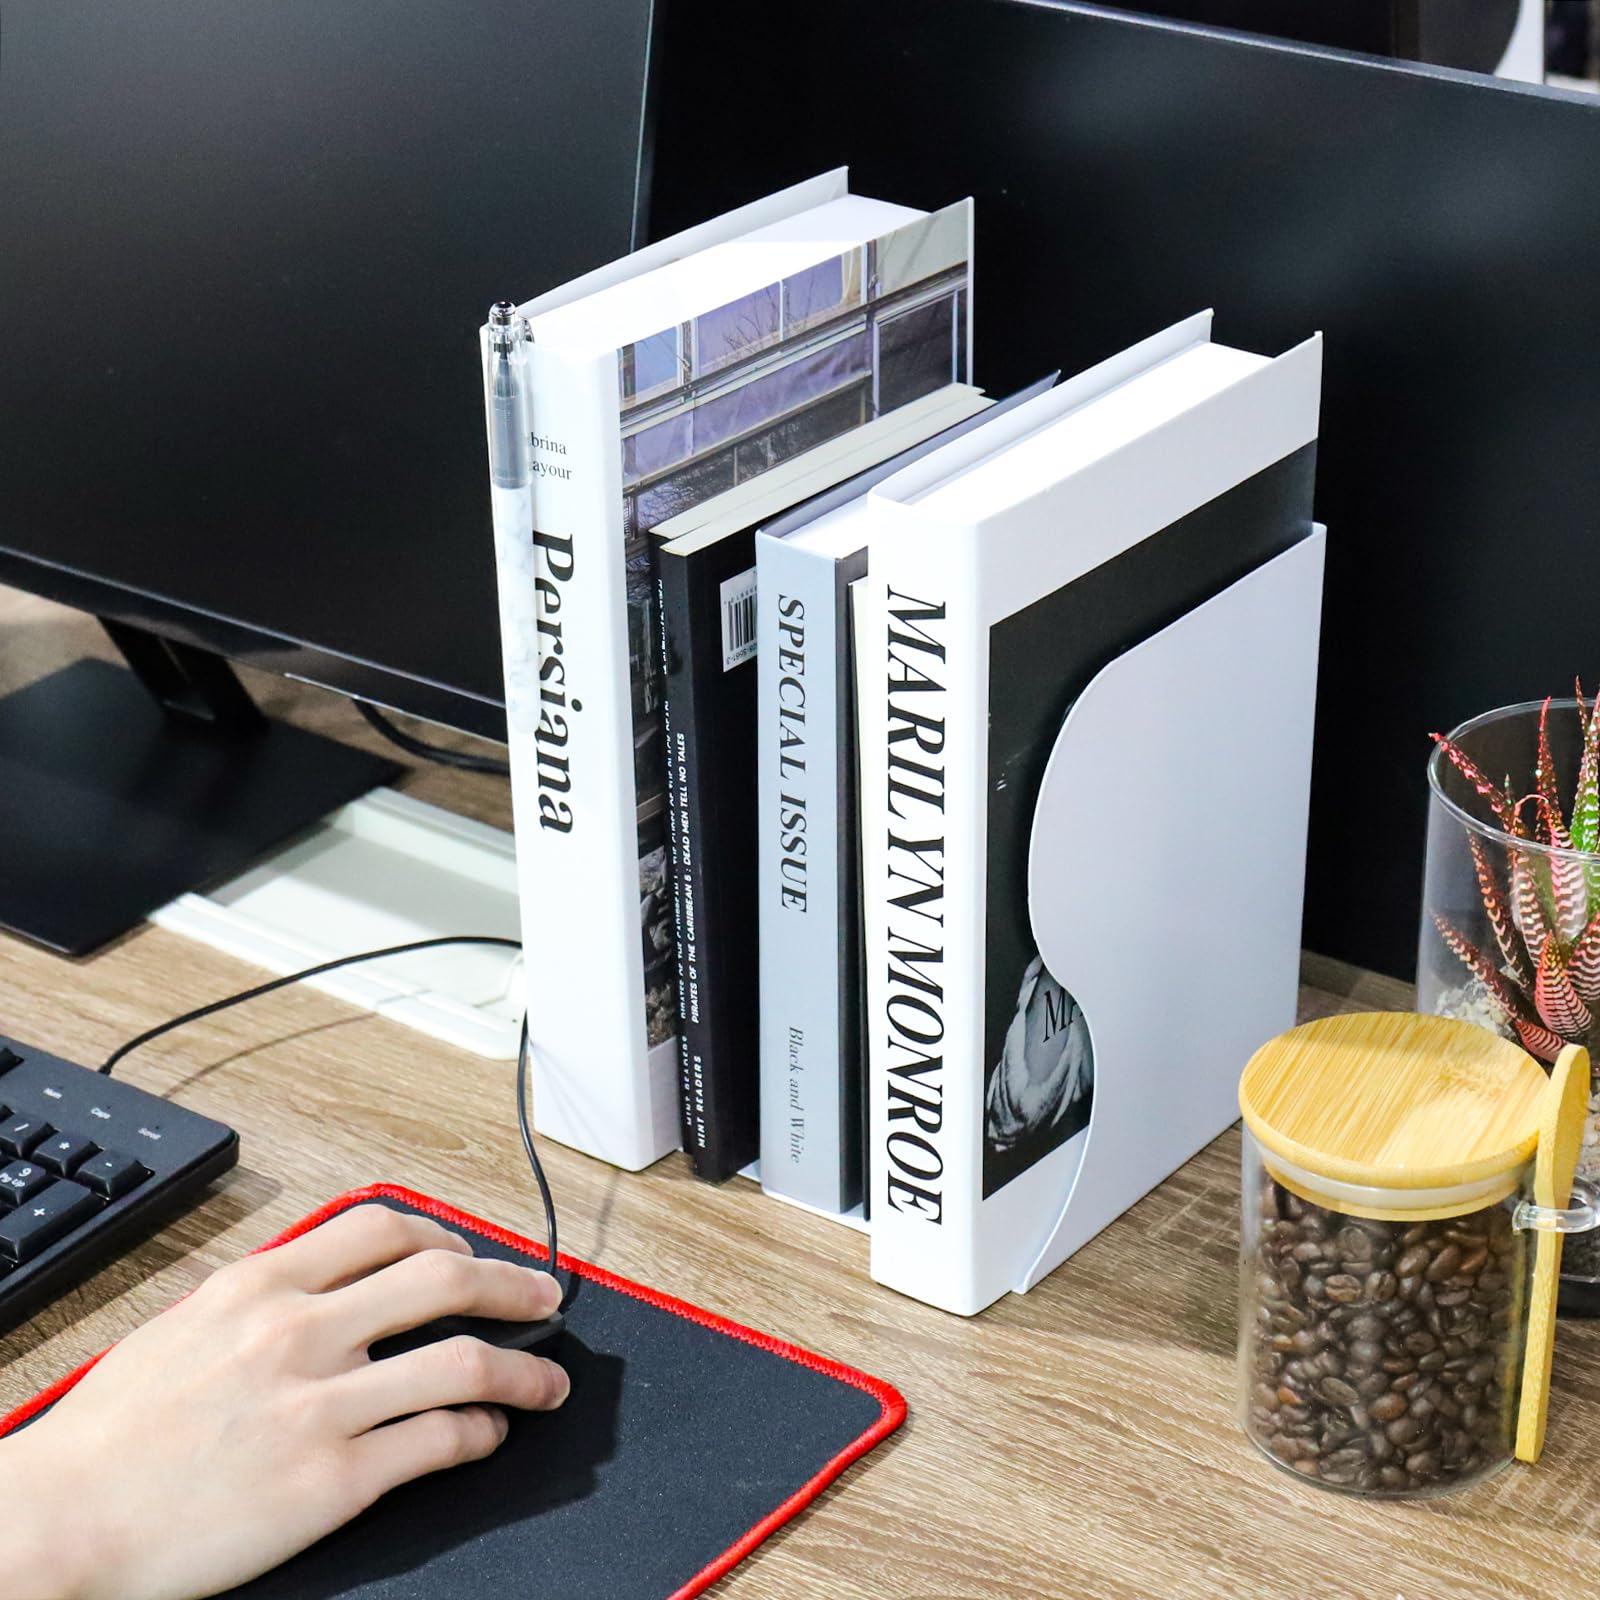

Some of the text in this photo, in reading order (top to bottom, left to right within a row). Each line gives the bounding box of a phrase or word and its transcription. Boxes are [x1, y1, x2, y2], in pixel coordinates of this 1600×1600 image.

[529, 431, 567, 455] brina
[531, 460, 573, 480] ayour
[533, 529, 583, 833] Persiana
[677, 733, 685, 762] TALES
[778, 594, 807, 913] SPECIAL ISSUE
[679, 766, 686, 782] NO
[680, 786, 688, 807] TELL
[681, 811, 689, 833] MEN
[682, 836, 691, 865] DEAD
[685, 884, 695, 941] CARIBBEAN
[886, 583, 947, 1226] MARILYN MONROE
[689, 965, 696, 979] OF
[690, 983, 699, 1023] PIRATES
[694, 1056, 705, 1148] MINT READERS
[789, 1026, 805, 1164] Black and White
[19, 1167, 32, 1177] 9
